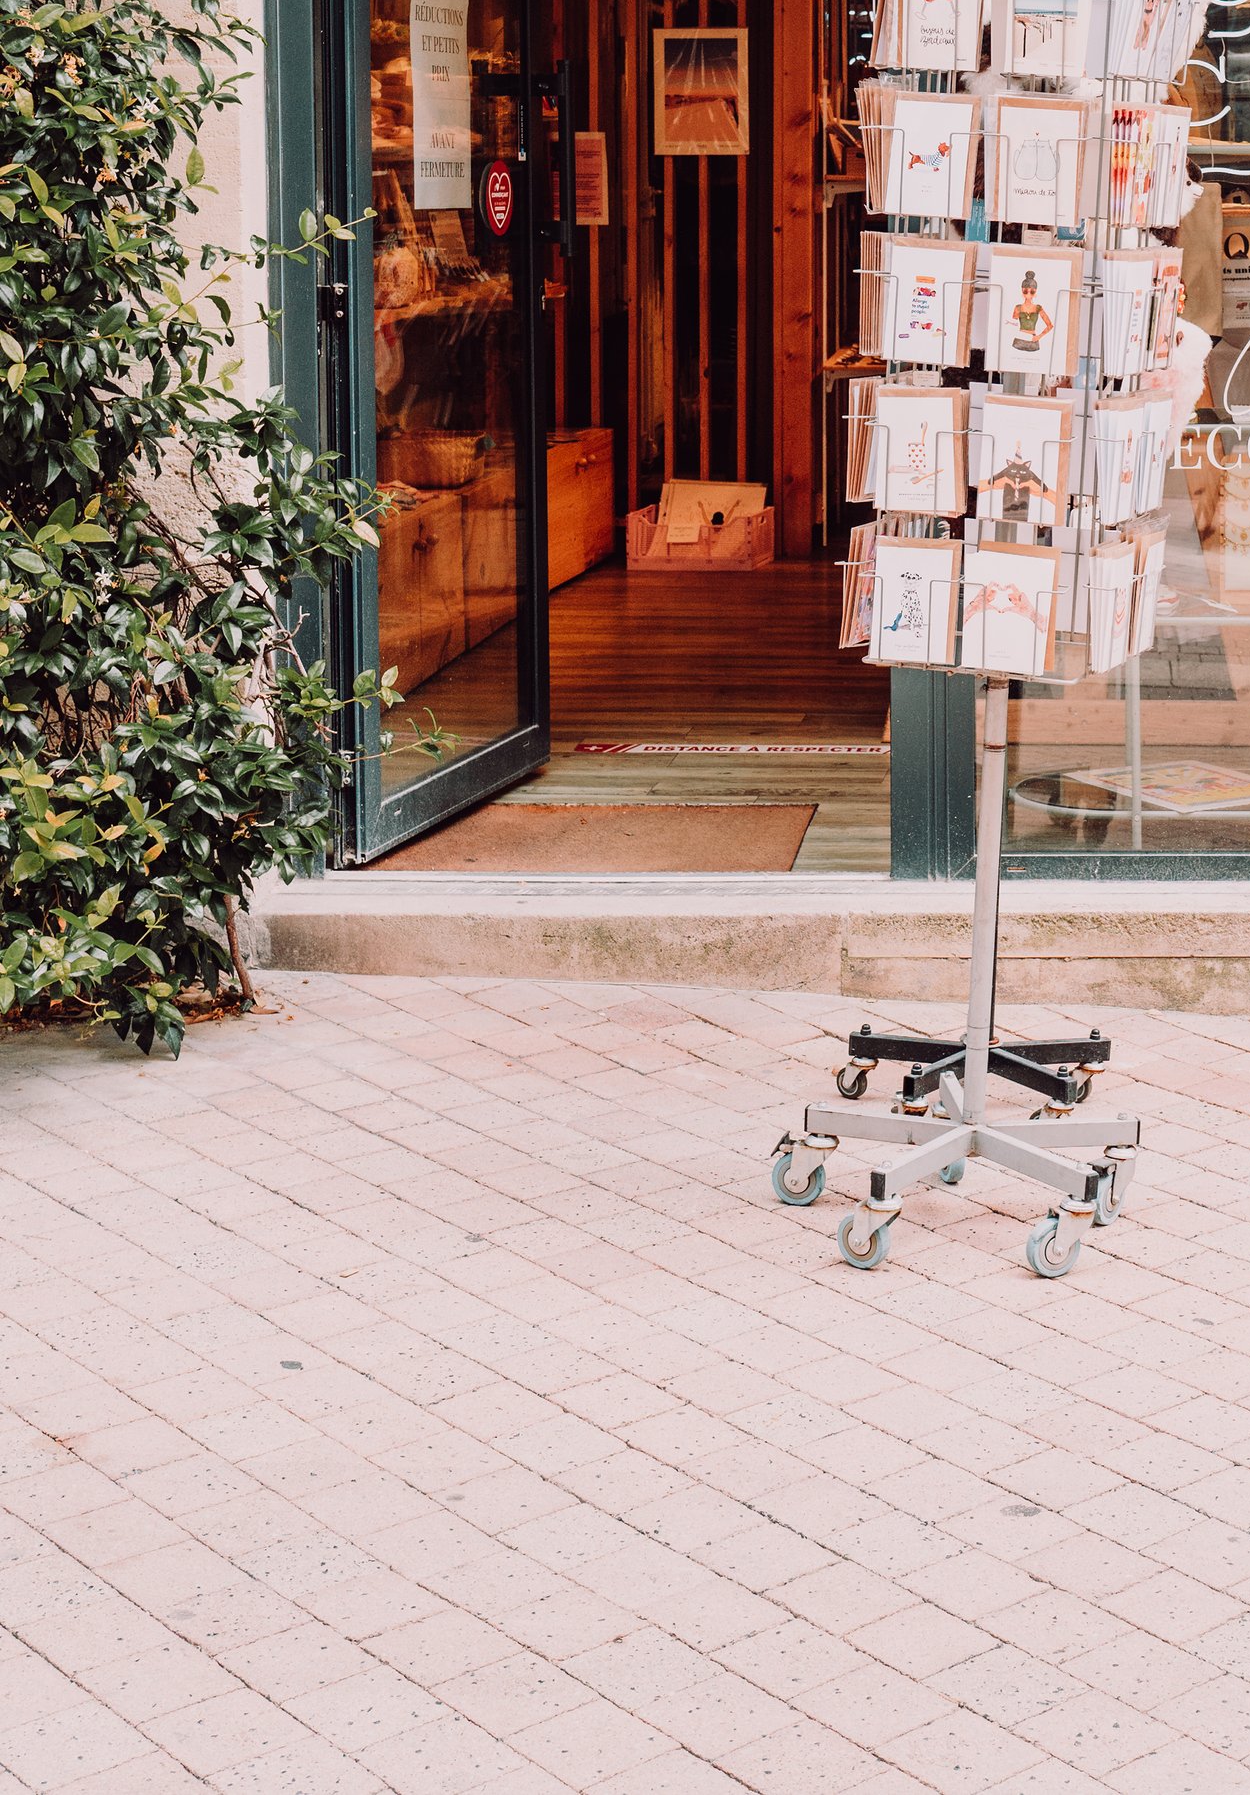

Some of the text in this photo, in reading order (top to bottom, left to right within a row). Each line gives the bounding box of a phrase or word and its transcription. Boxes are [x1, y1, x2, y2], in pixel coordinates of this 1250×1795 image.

[414, 1, 464, 27] RÉDUCTIONS
[422, 34, 461, 55] ET PETITS
[431, 64, 451, 83] PRIX
[430, 131, 456, 149] AVANT
[420, 161, 466, 179] FERMETURE
